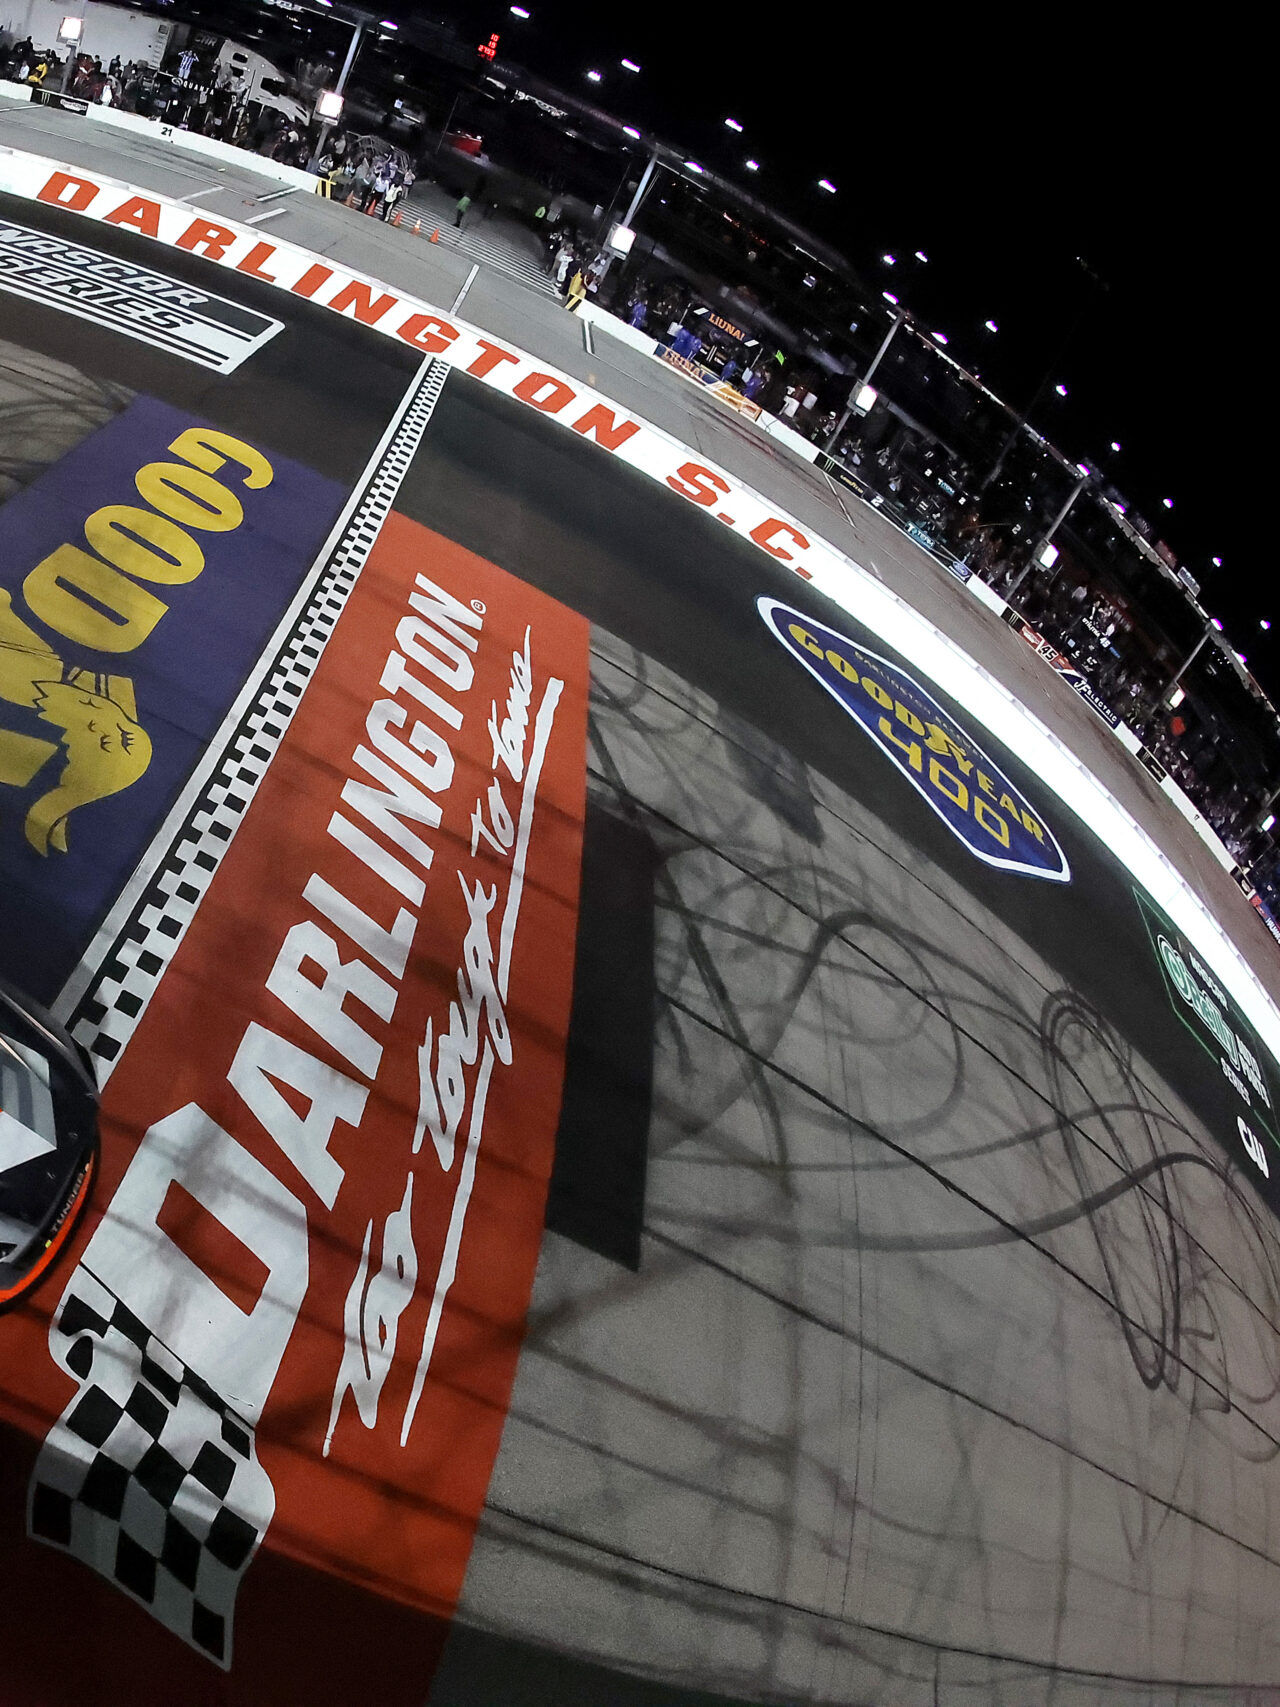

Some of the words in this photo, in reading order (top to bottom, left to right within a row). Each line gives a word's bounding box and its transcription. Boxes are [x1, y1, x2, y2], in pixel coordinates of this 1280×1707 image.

[160, 127, 173, 137] 21
[37, 170, 641, 451] DARLINGTON
[1040, 644, 1058, 662] 45
[879, 716, 1010, 848] 400
[46, 573, 487, 1440] DARLINGTON
